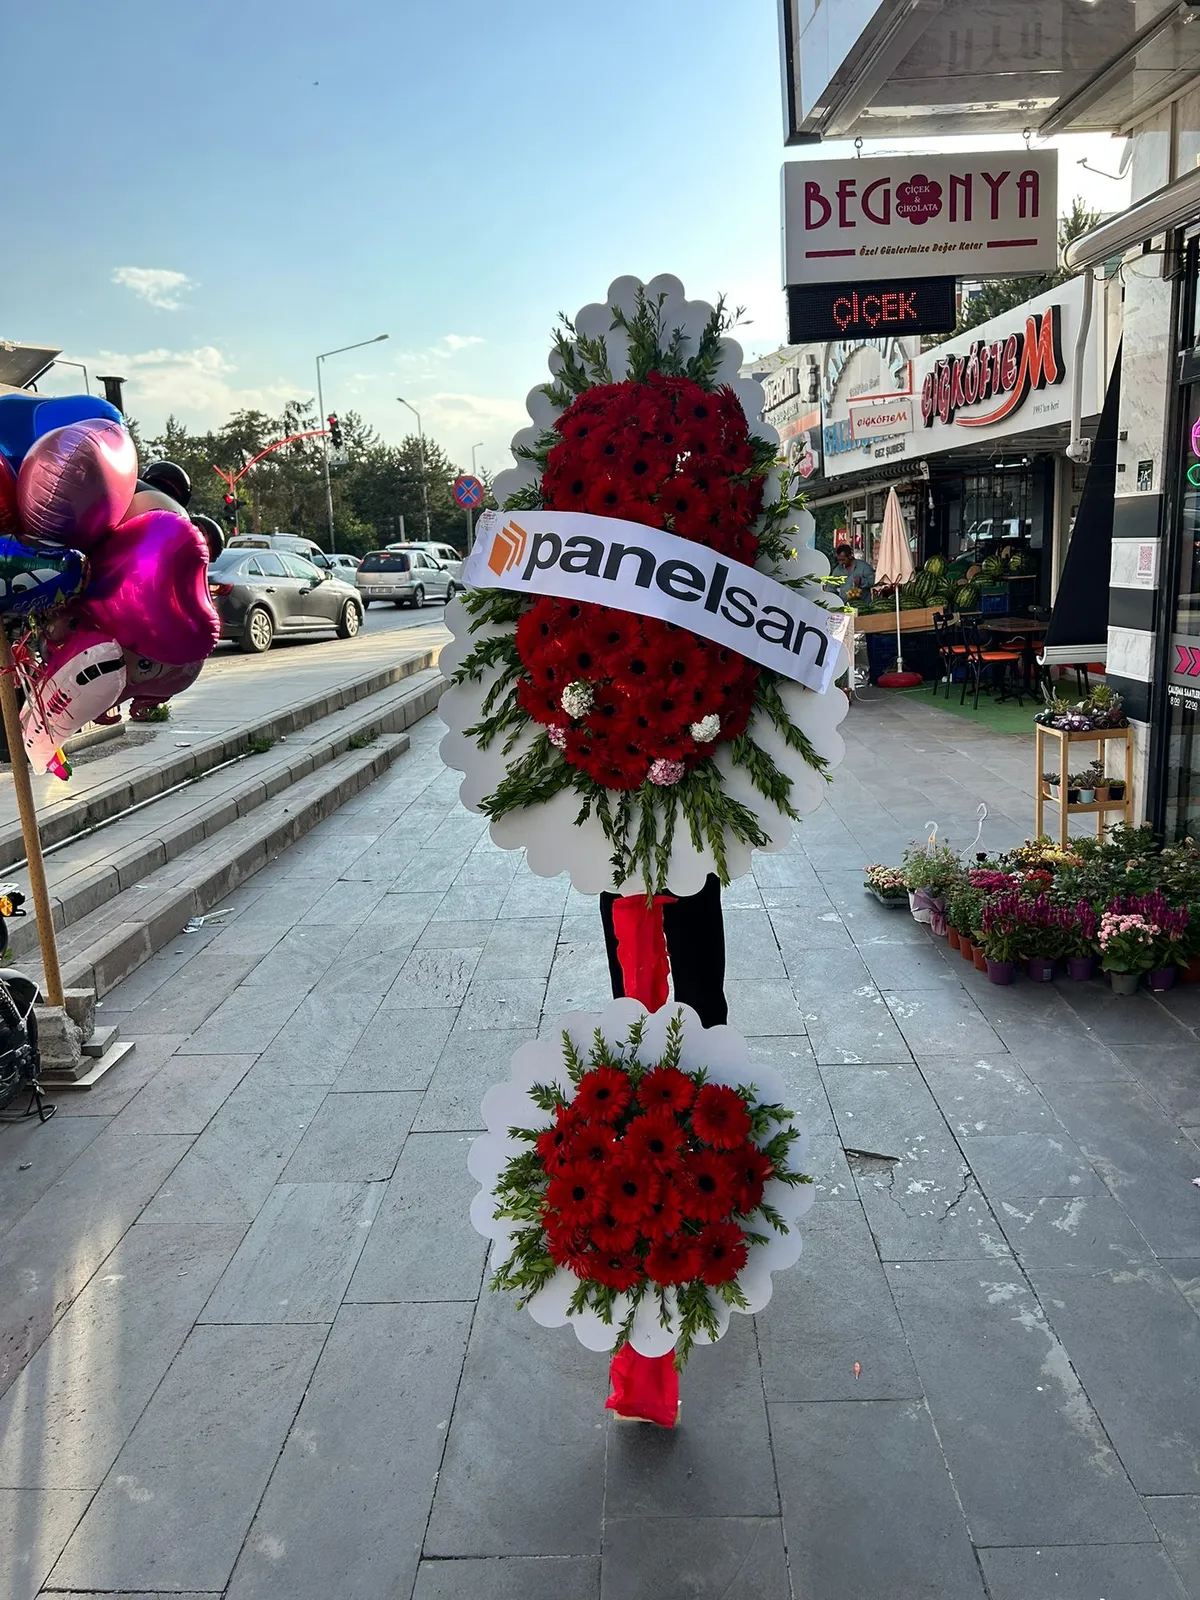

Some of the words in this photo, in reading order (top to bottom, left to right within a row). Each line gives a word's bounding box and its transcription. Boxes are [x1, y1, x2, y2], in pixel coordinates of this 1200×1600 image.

[905, 185, 931, 196] ÇİÇEK
[914, 196, 921, 204] &
[859, 245, 879, 257] Özel
[880, 244, 930, 255] Günlerimize
[932, 242, 957, 254] Değer
[959, 241, 984, 251] Katar
[521, 531, 830, 667] panelsan
